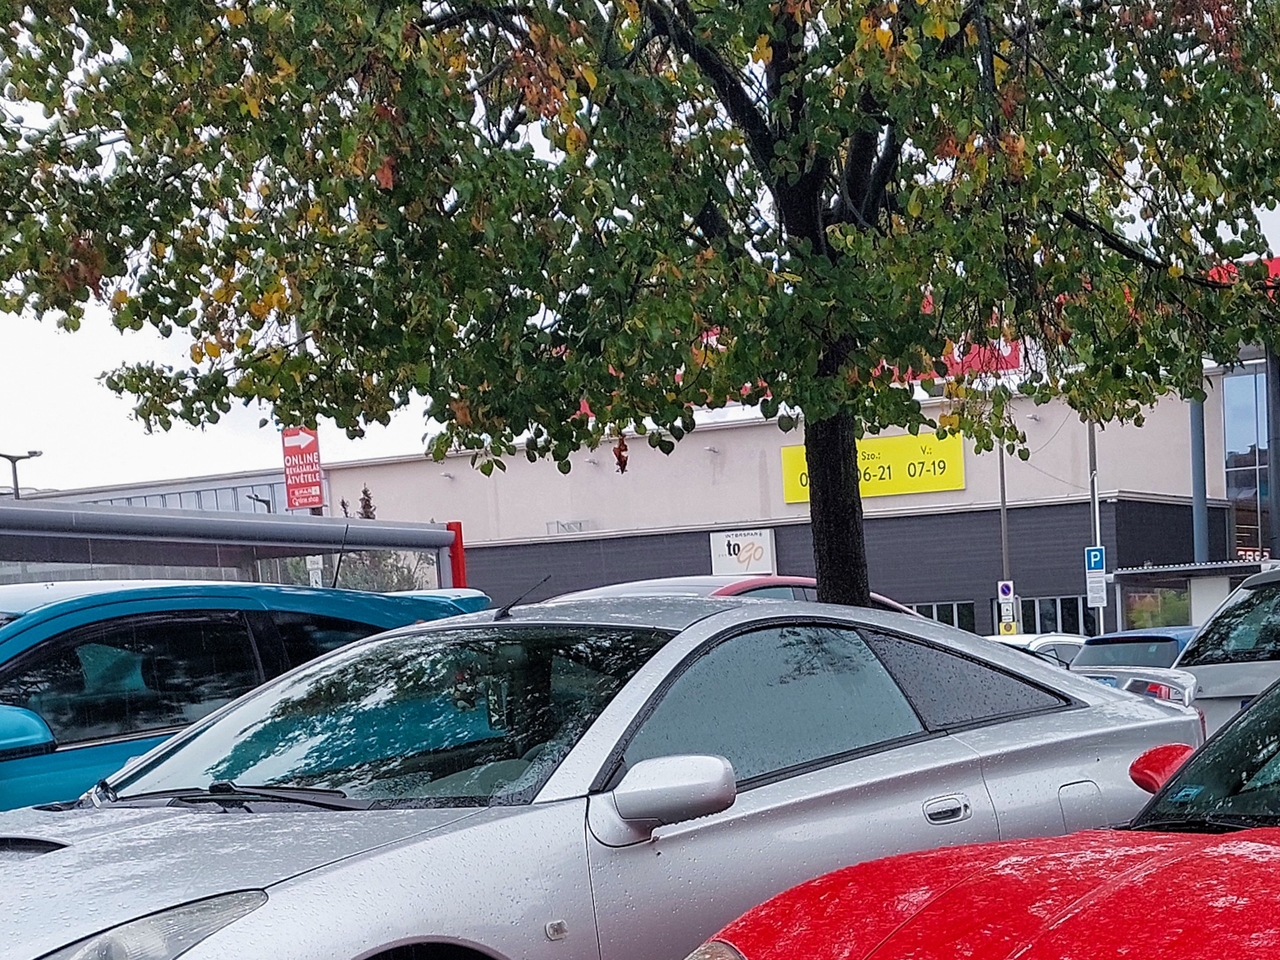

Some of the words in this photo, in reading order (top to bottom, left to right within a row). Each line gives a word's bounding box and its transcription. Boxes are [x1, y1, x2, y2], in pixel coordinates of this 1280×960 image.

[285, 452, 318, 466] ONLINE
[907, 459, 947, 478] 07-19
[287, 473, 320, 485] ÁTVÉTELE
